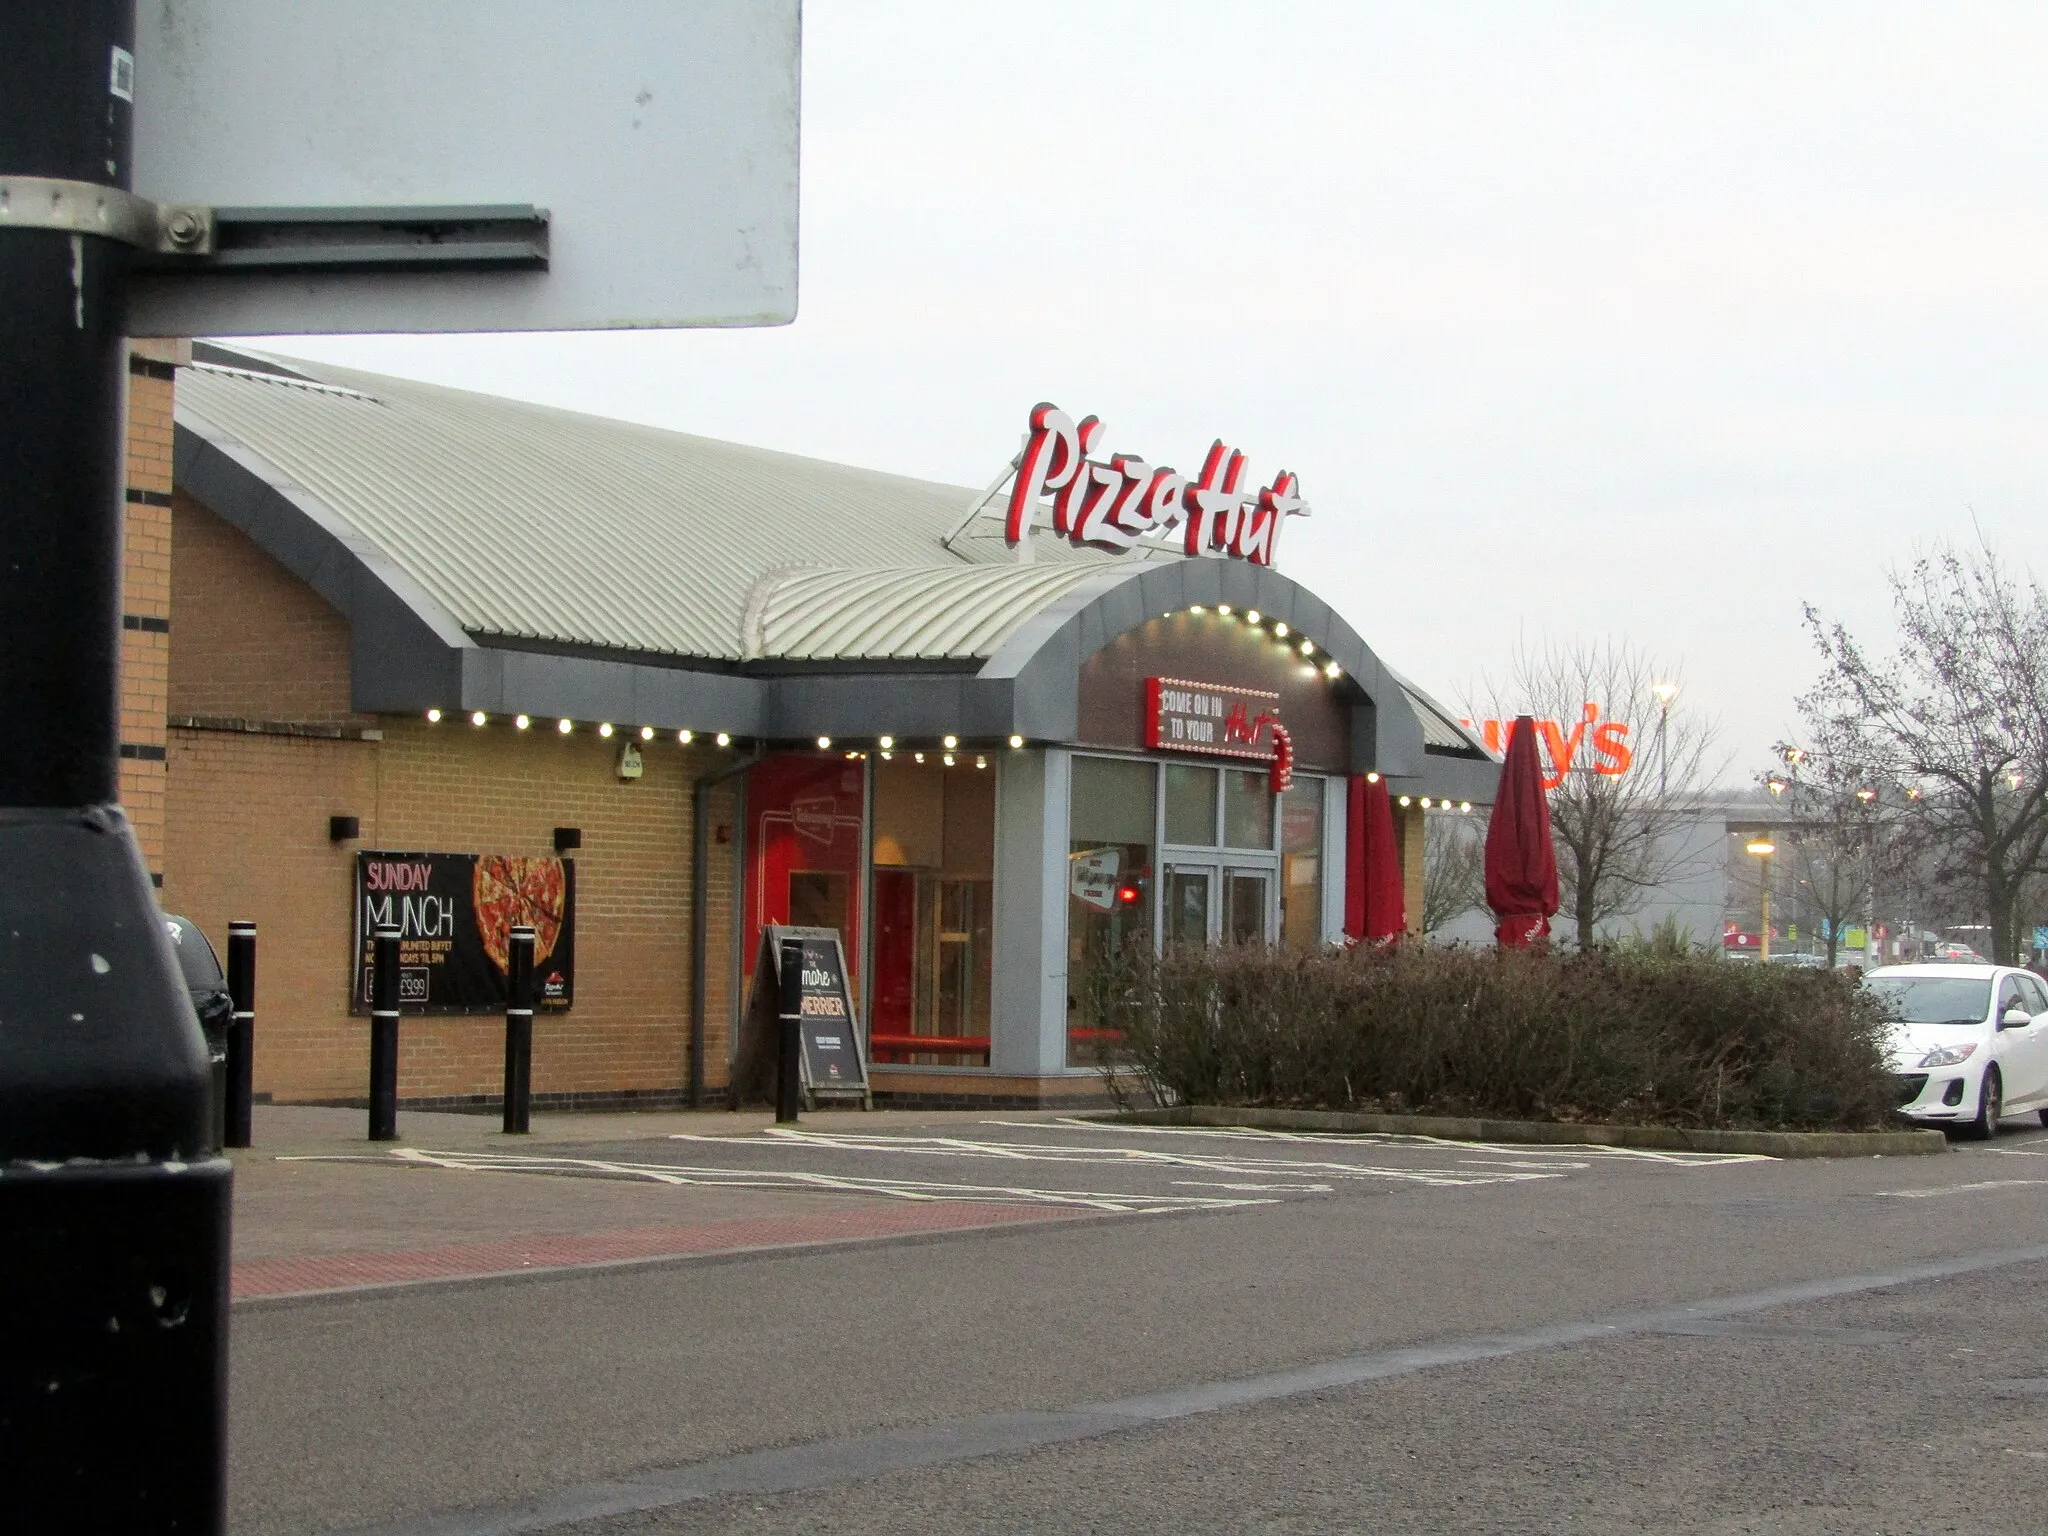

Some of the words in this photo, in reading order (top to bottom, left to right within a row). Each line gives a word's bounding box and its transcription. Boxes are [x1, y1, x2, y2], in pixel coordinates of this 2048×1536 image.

[1005, 402, 1189, 555] Pizza
[1184, 439, 1309, 563] Hut
[1162, 690, 1192, 713] COME
[1194, 694, 1209, 716] ON
[1211, 696, 1222, 717] IN
[1171, 717, 1184, 739] TO
[1186, 720, 1214, 743] YOUR
[367, 862, 432, 891] SUNDAY
[366, 895, 453, 936] MUNCH
[801, 969, 830, 986] more
[801, 996, 846, 1017] MERRIER
